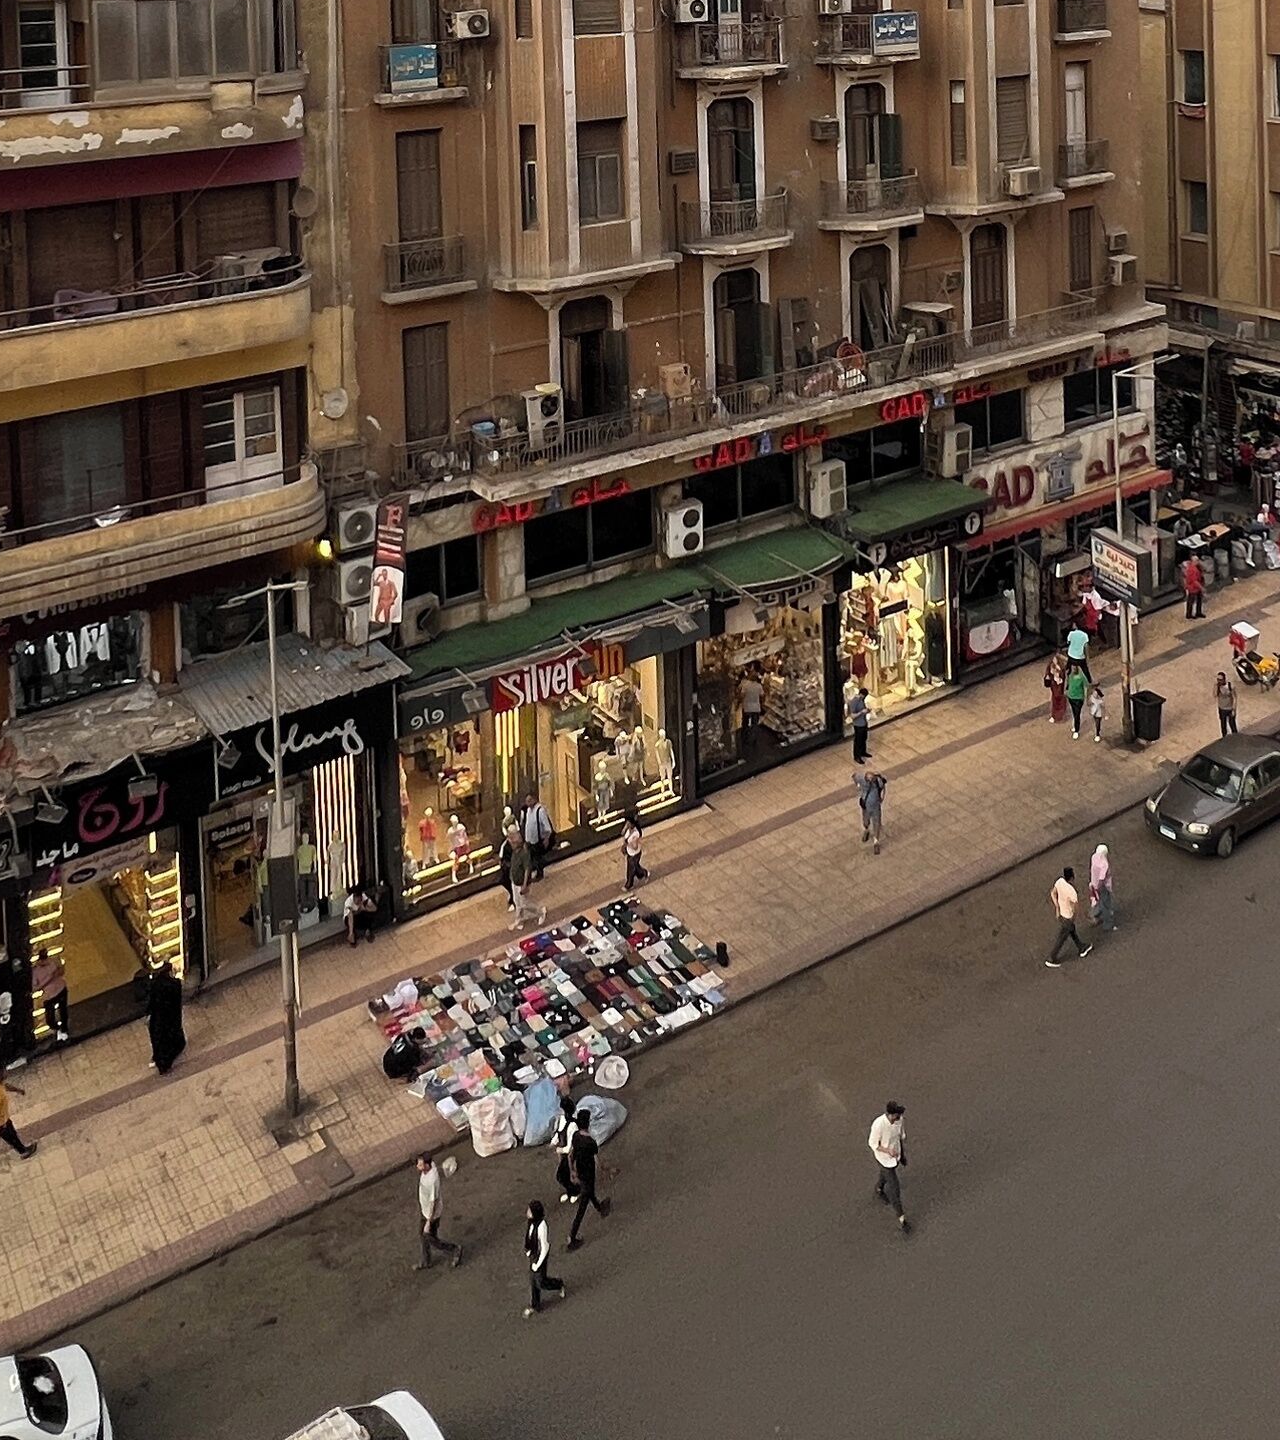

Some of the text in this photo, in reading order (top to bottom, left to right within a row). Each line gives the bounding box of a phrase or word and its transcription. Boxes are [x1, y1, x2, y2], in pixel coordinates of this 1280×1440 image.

[880, 389, 928, 423] GAD
[255, 717, 364, 773] Slang
[36, 841, 80, 868] ماجد
